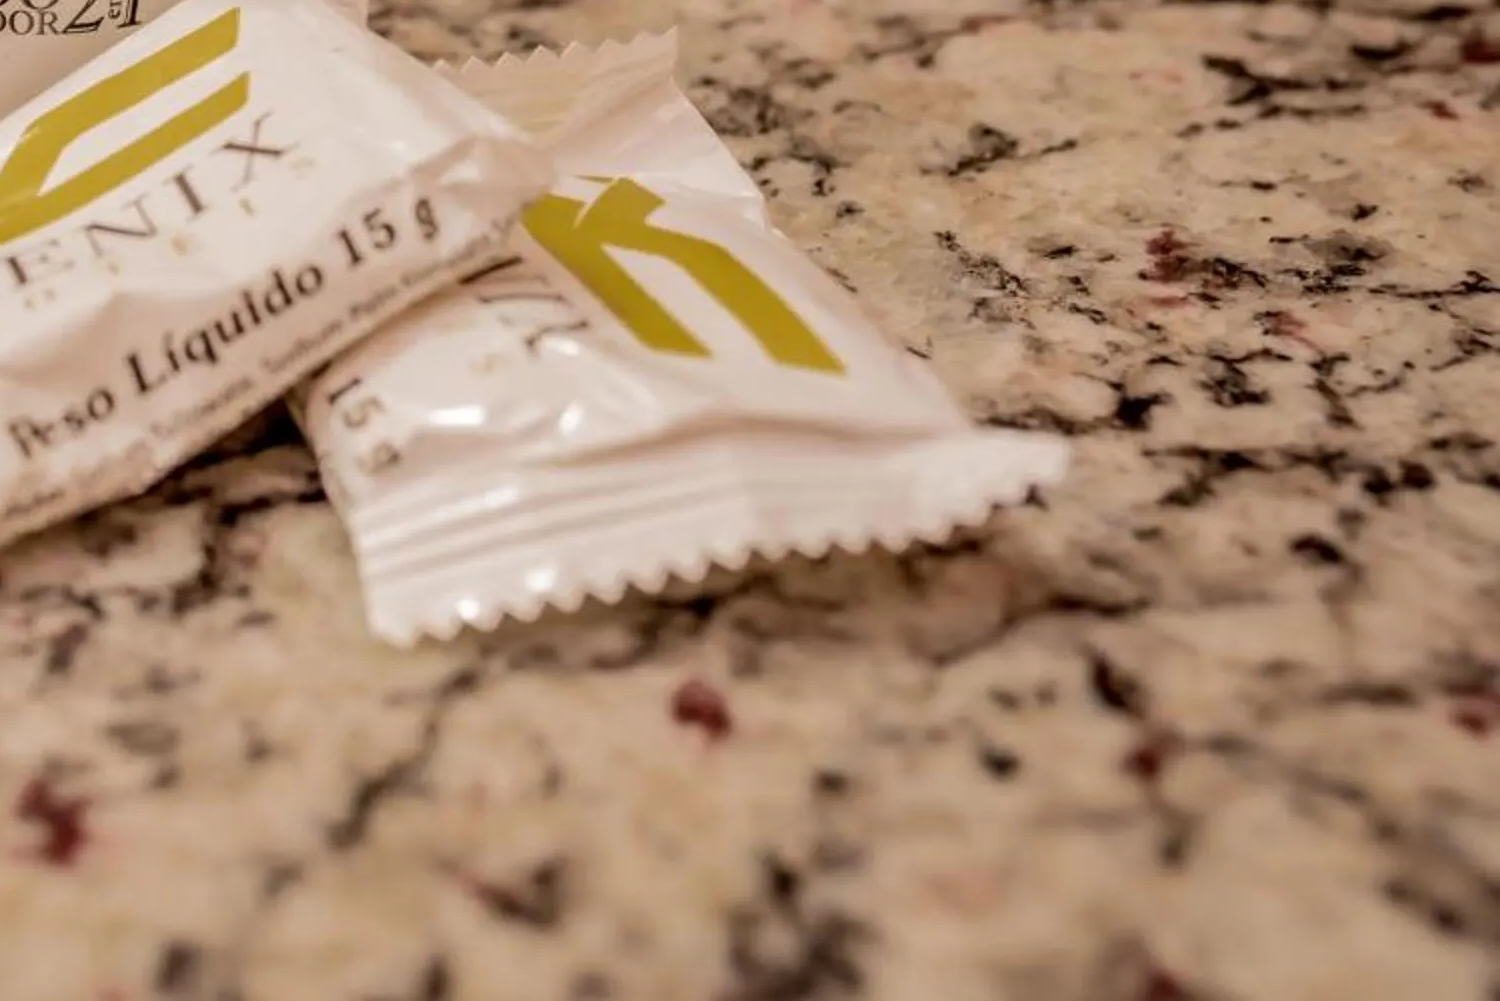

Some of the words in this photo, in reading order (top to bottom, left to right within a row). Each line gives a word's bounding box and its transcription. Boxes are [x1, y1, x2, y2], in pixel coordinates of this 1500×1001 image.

[125, 264, 324, 394] Líquido
[338, 206, 398, 266] 15
[414, 197, 440, 241] g
